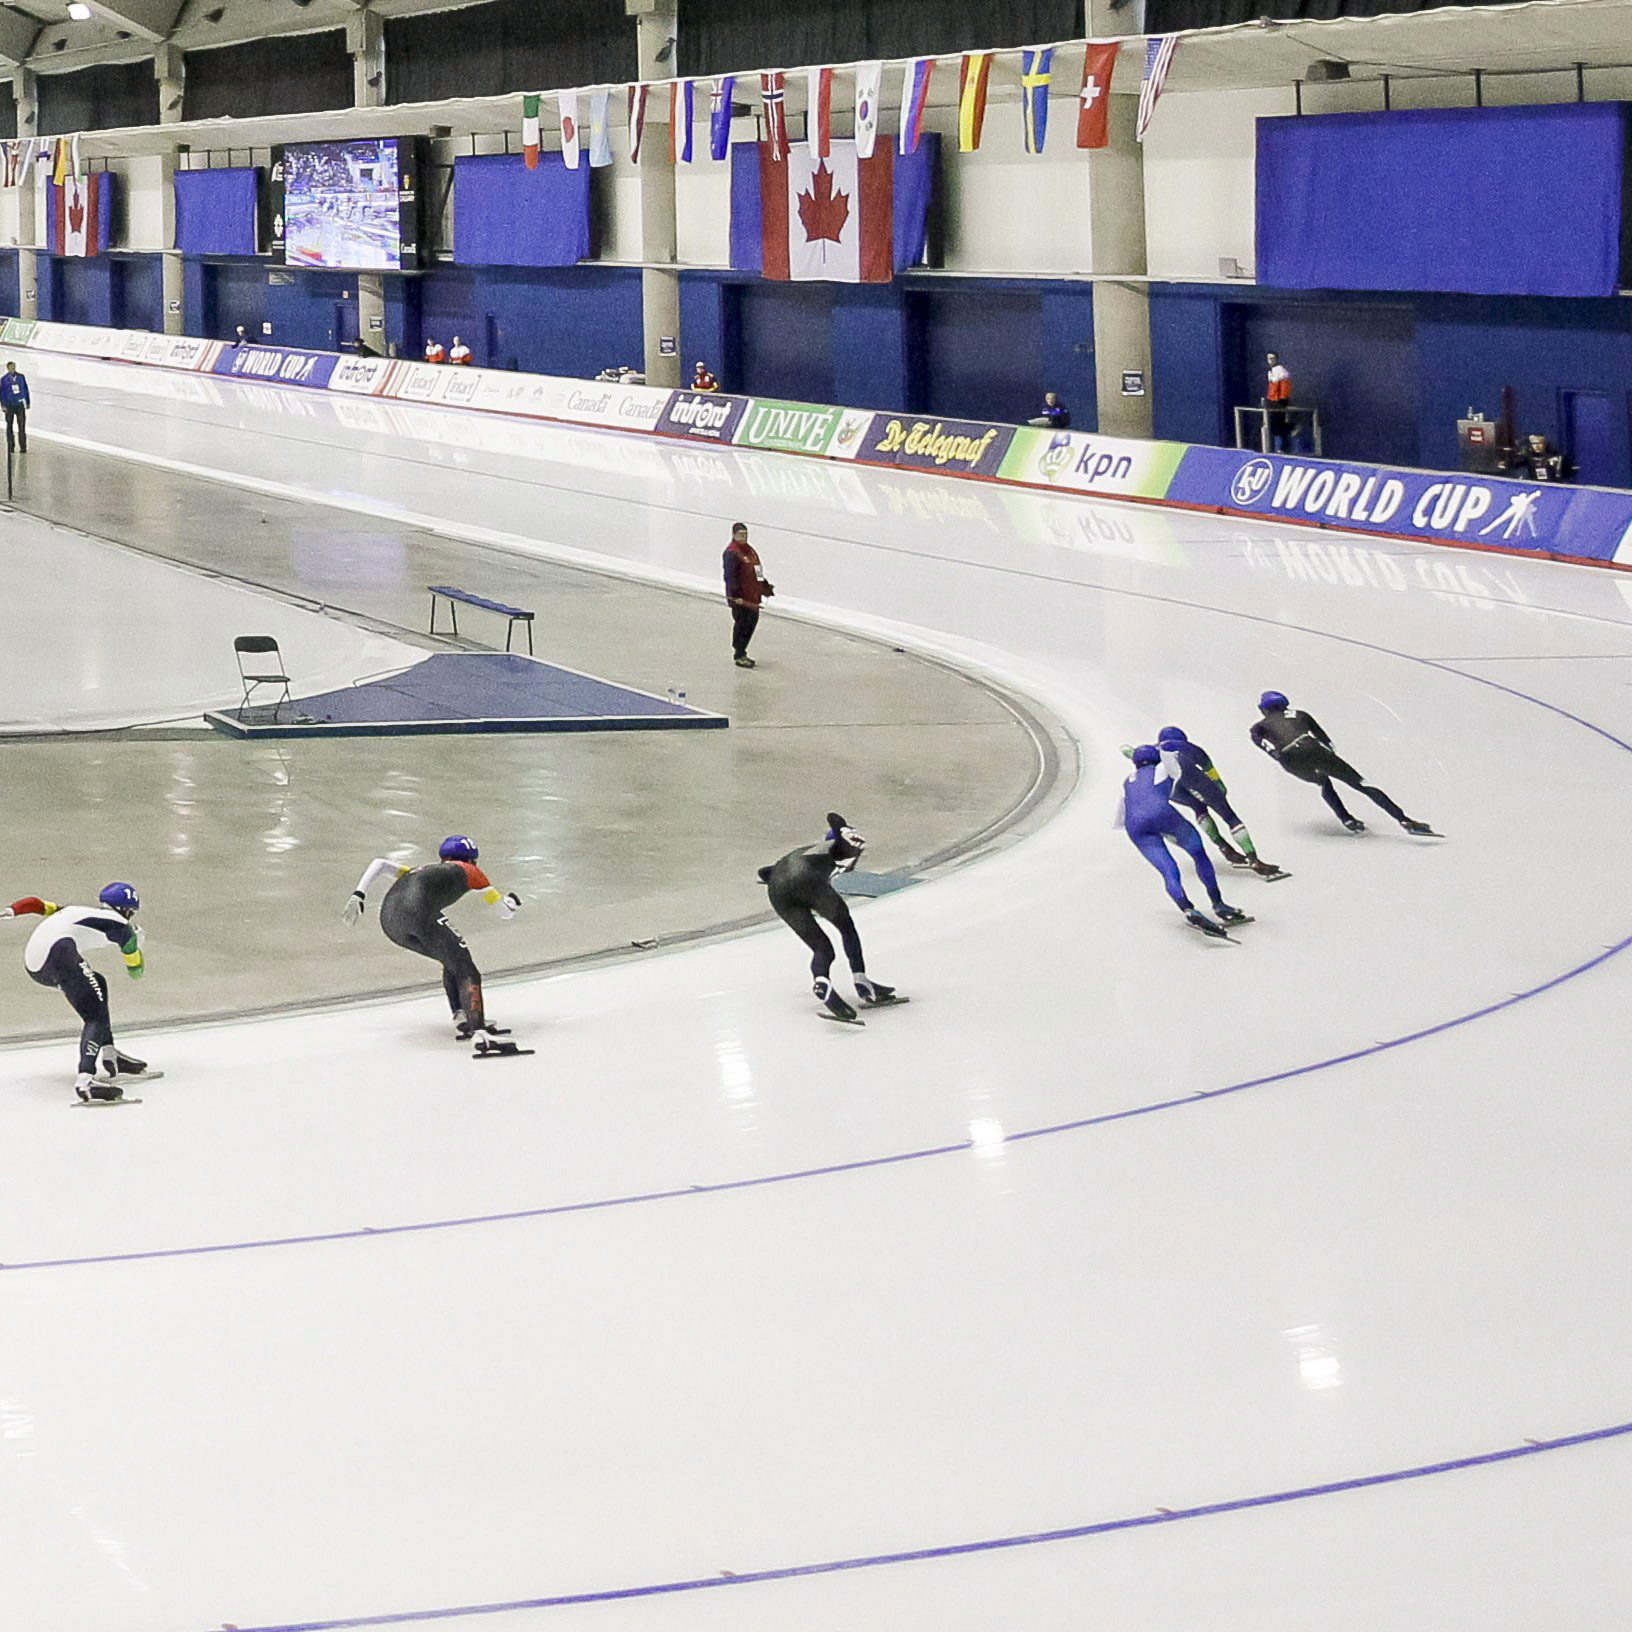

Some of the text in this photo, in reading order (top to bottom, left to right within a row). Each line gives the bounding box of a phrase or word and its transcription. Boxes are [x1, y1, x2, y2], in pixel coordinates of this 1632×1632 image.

[242, 349, 283, 377] WORLD
[670, 394, 732, 429] infront
[750, 407, 835, 452] UNIVÉ
[1074, 444, 1133, 483] kpn
[1272, 465, 1406, 524] WORLD
[1413, 482, 1493, 533] CUP
